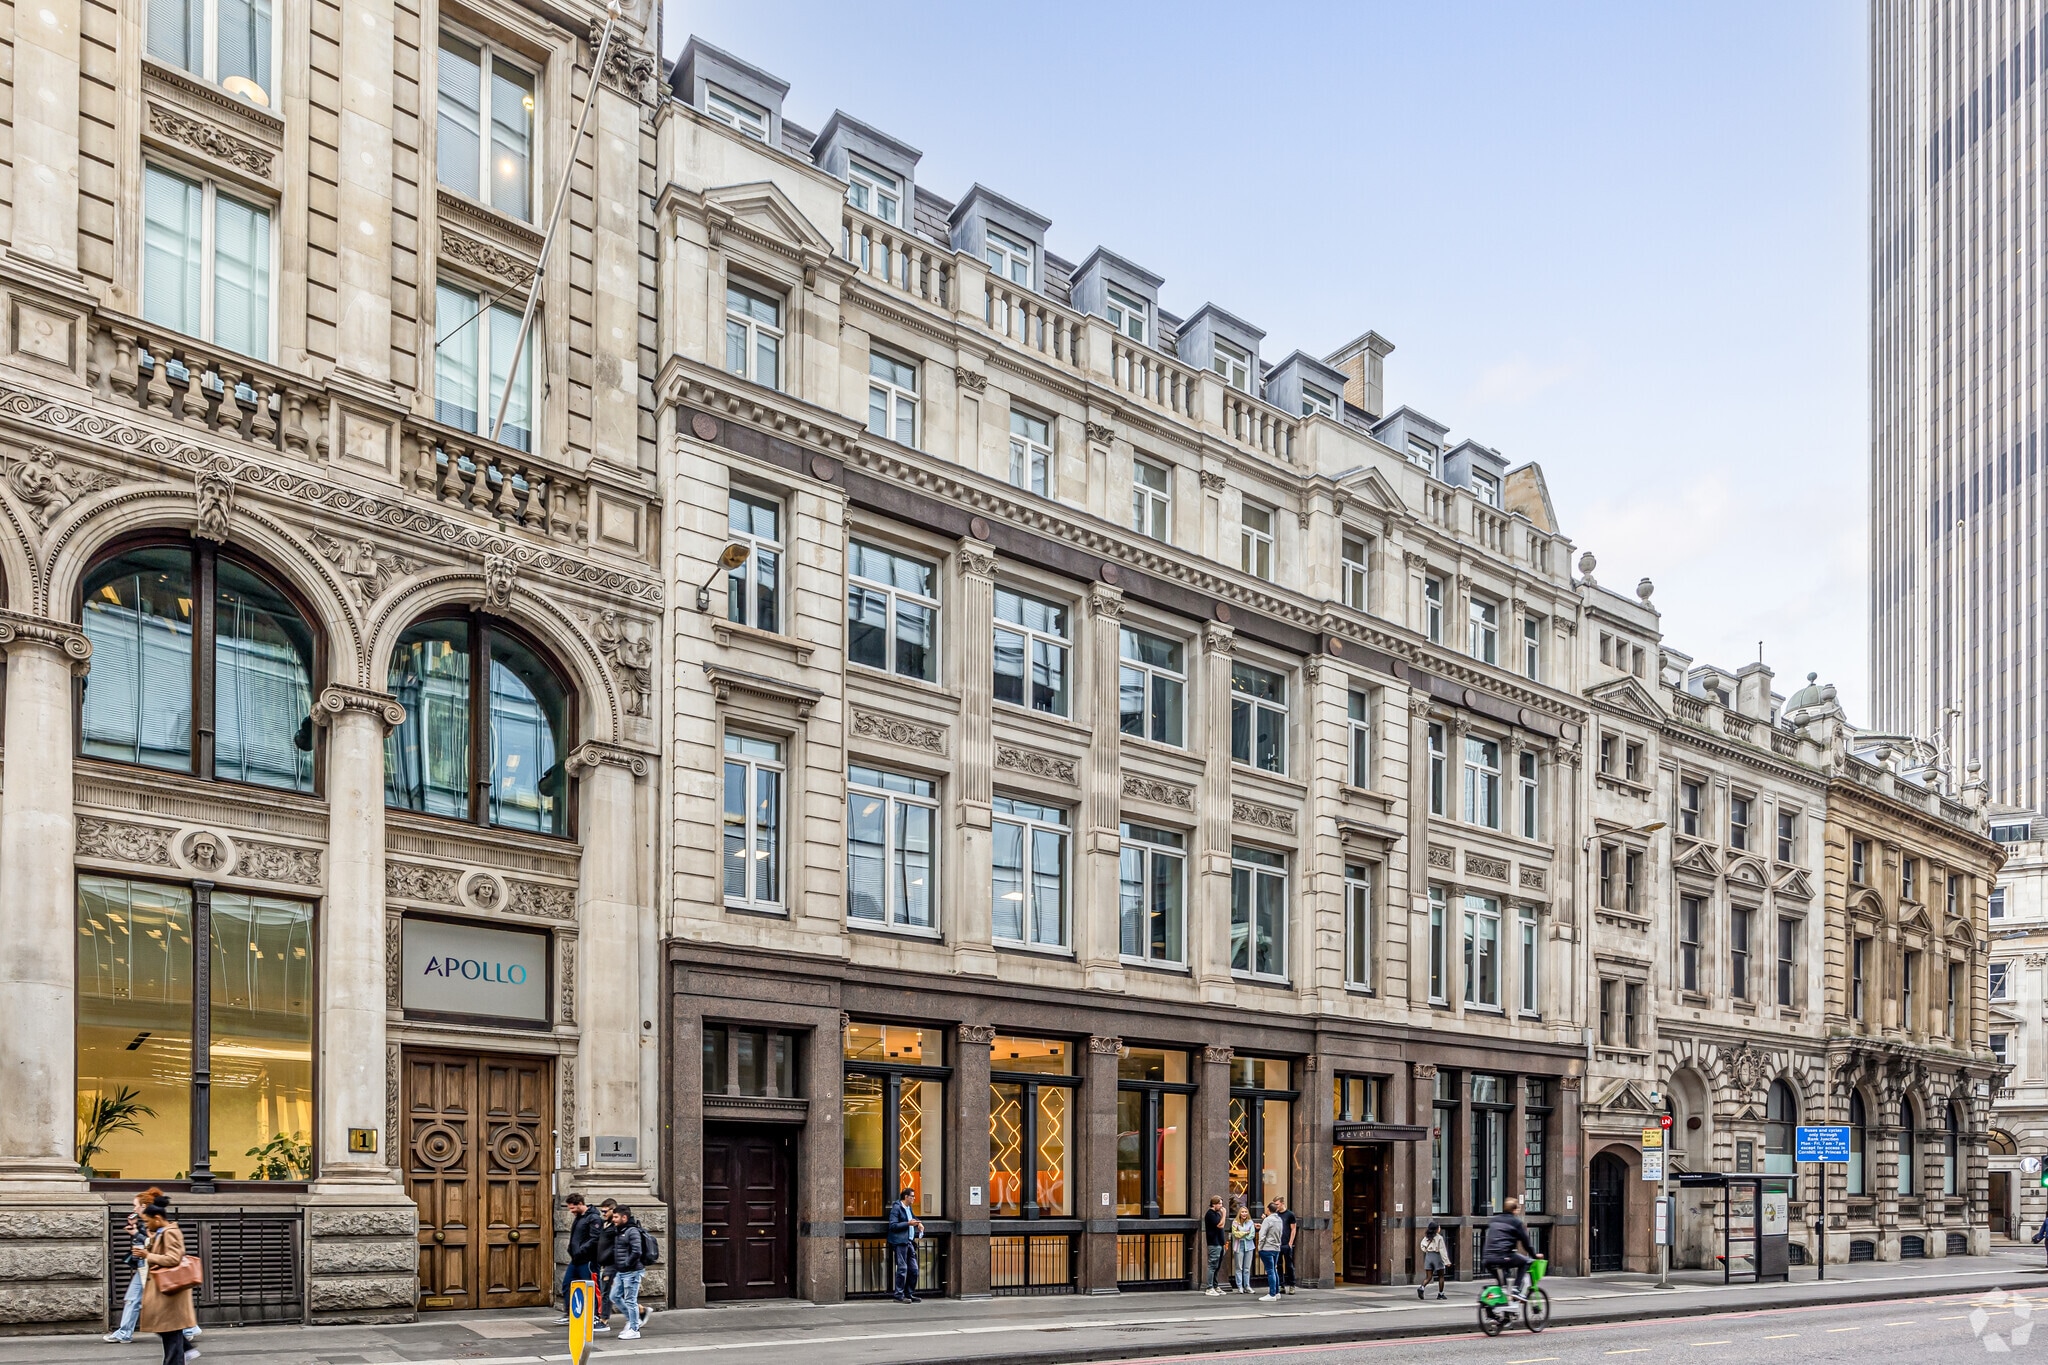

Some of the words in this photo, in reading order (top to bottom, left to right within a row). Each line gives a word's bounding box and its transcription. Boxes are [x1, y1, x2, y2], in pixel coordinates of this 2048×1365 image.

[424, 956, 527, 985] APOLLO
[359, 1132, 369, 1148] 1
[1340, 1130, 1371, 1138] seven
[613, 1140, 620, 1152] 1
